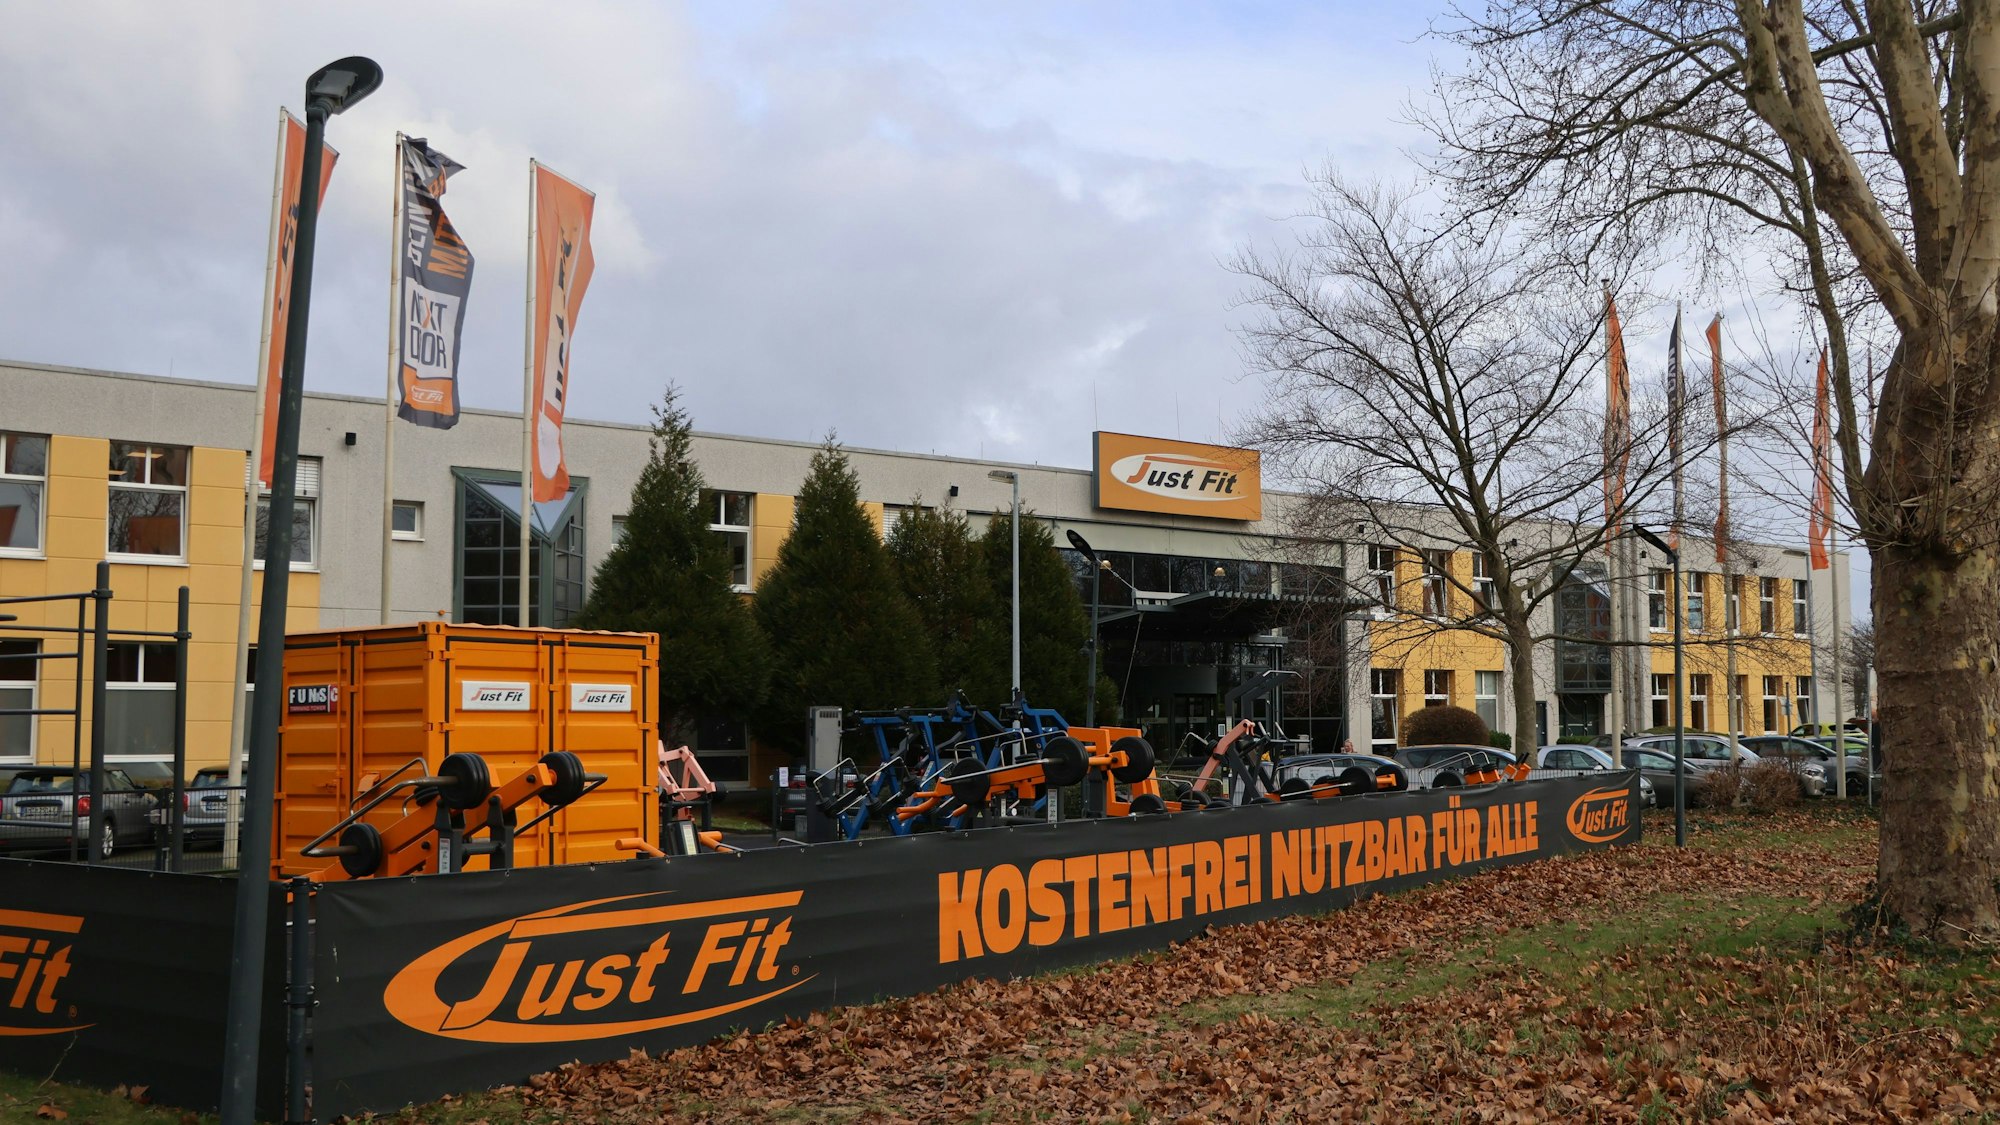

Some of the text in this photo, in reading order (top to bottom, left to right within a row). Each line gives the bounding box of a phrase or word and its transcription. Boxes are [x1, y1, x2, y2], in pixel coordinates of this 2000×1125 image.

[1126, 460, 1238, 495] Just Fit
[470, 689, 523, 702] Just Fit
[579, 692, 625, 704] Just Fit
[1574, 798, 1628, 834] Just Fit
[938, 795, 1539, 964] KOSTENFREI NUTZBAR FÜR ALLE
[438, 915, 792, 1032] Just Fit
